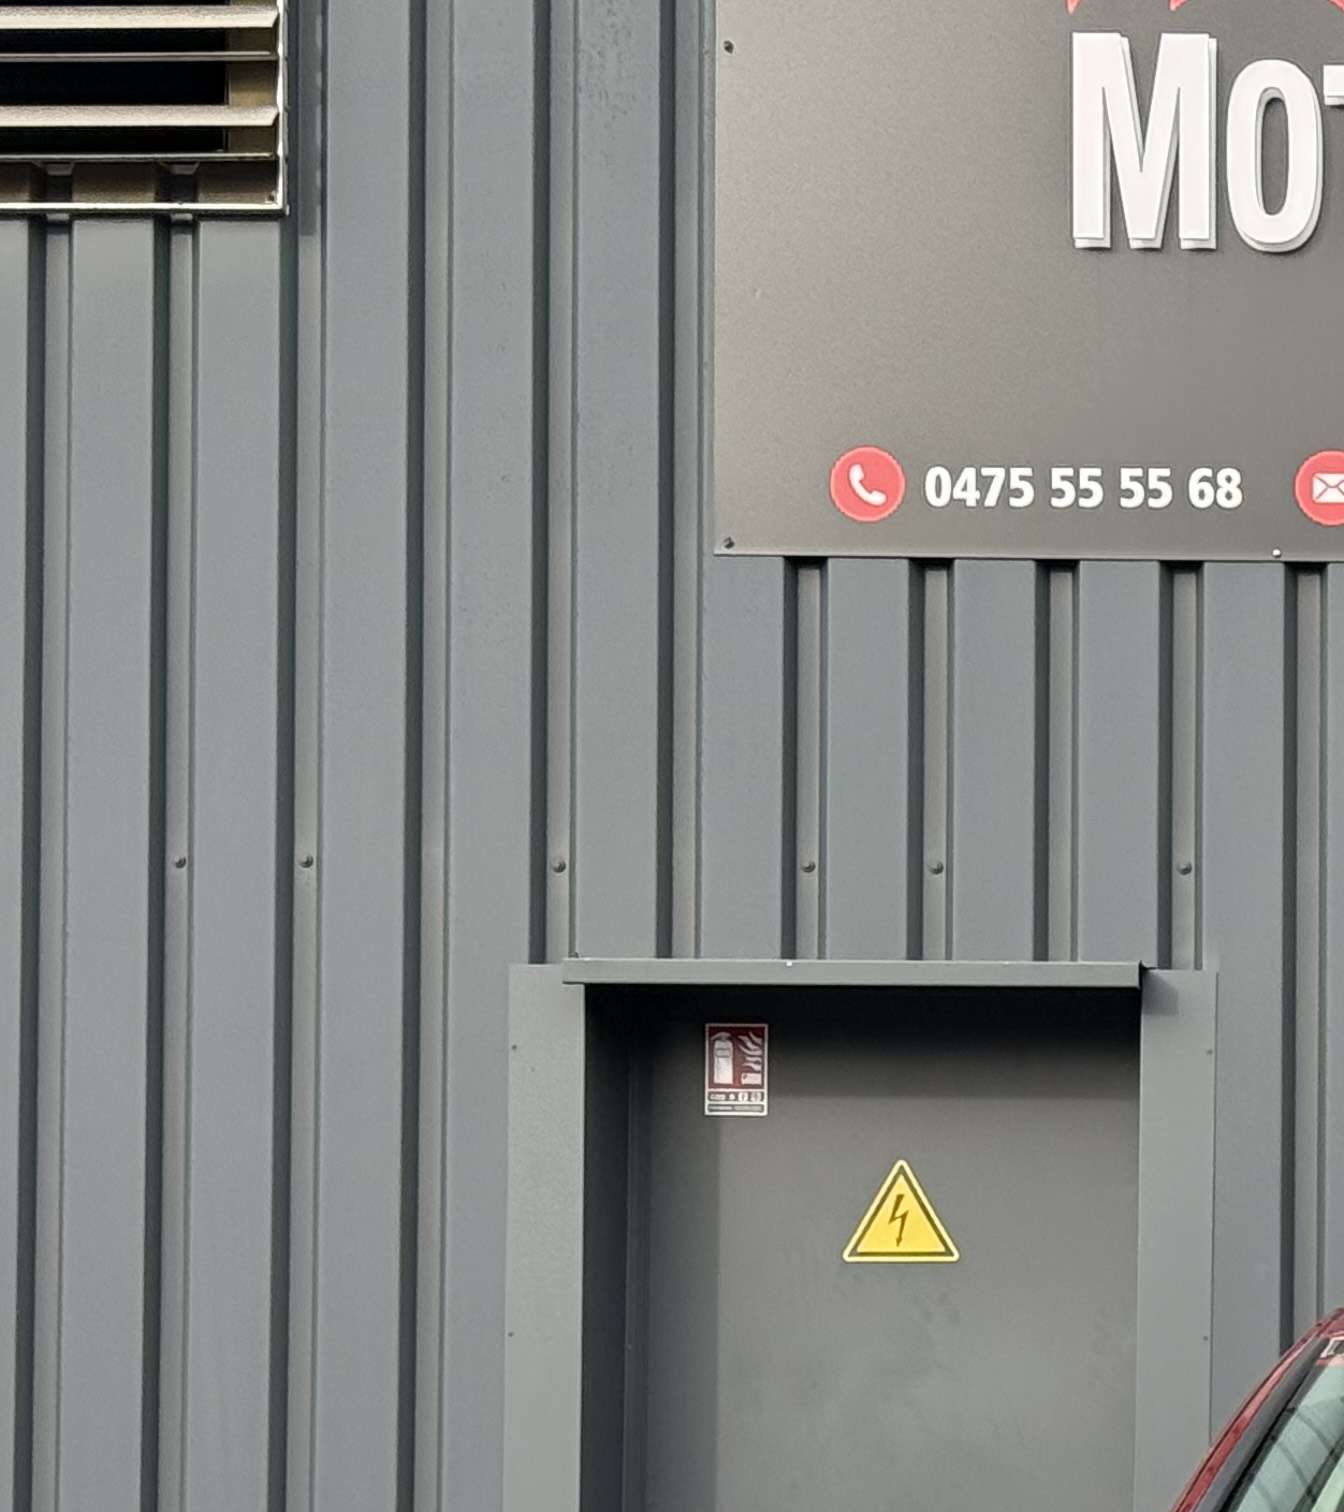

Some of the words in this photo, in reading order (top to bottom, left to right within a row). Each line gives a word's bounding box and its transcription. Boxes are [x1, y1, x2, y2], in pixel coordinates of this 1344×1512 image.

[925, 466, 1035, 508] 0475
[1050, 467, 1104, 508] 55
[1120, 467, 1173, 508] 55
[1188, 467, 1243, 509] 68
